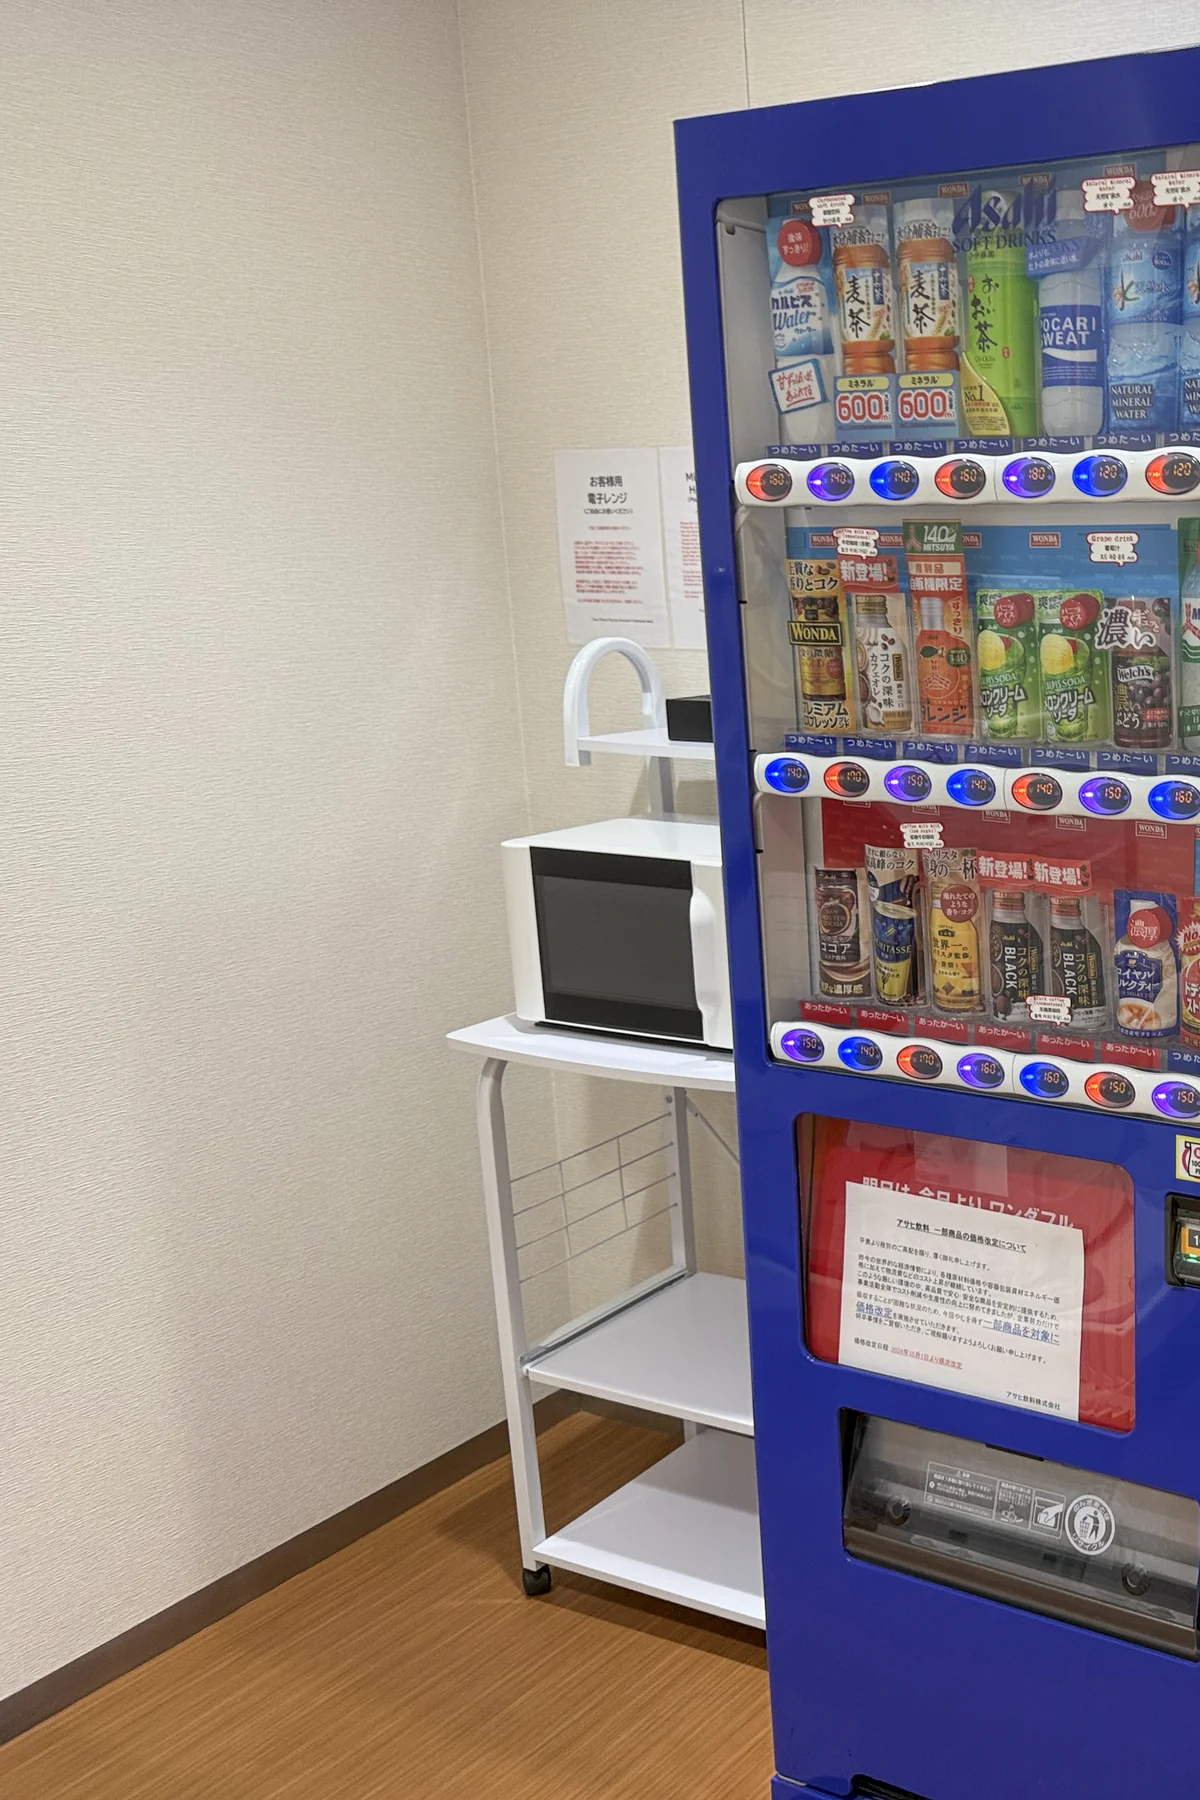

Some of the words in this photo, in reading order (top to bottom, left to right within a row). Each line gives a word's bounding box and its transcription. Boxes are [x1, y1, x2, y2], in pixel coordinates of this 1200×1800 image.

[952, 236, 993, 253] SOFT
[996, 229, 1056, 249] DRINKS
[846, 275, 871, 338] 麦茶
[911, 270, 936, 334] 麦茶
[773, 308, 817, 331] Water
[1111, 384, 1153, 395] NATURAL
[1112, 396, 1152, 407] MINERAL
[1115, 409, 1147, 419] WATER
[1028, 467, 1046, 480] 180
[1173, 462, 1192, 476] 120
[589, 476, 623, 487] お客様用
[769, 473, 785, 485] 160
[831, 472, 847, 484] 140
[961, 470, 977, 482] 160
[587, 492, 628, 504] 電子レンジ
[1032, 534, 1058, 543] WONDA
[1091, 535, 1113, 543] Grape
[923, 542, 955, 551] MITSUYA
[840, 560, 889, 582] 新登場!
[791, 622, 837, 642] WONDA
[870, 653, 881, 696] カフェオレ
[999, 672, 1017, 682] SODA
[1117, 665, 1153, 681] Welch's
[879, 652, 894, 708] コクの深味
[1063, 676, 1086, 688] SODA
[987, 703, 1007, 718] ソーダ
[1054, 707, 1077, 723] ソーダ
[846, 771, 862, 782] 170
[907, 775, 923, 787] 150
[1036, 783, 1053, 795] 140
[1104, 787, 1122, 800] 150
[1058, 817, 1084, 827] WONDA
[978, 856, 1028, 880] 新登場!
[1034, 861, 1082, 887] 新登場!
[1004, 946, 1017, 989] BLACK
[1062, 953, 1078, 996] BLACK
[803, 1038, 816, 1048] 150
[919, 1054, 935, 1066] 170
[981, 1062, 996, 1074] 160
[1110, 1081, 1126, 1093] 150
[1177, 1091, 1194, 1104] 150
